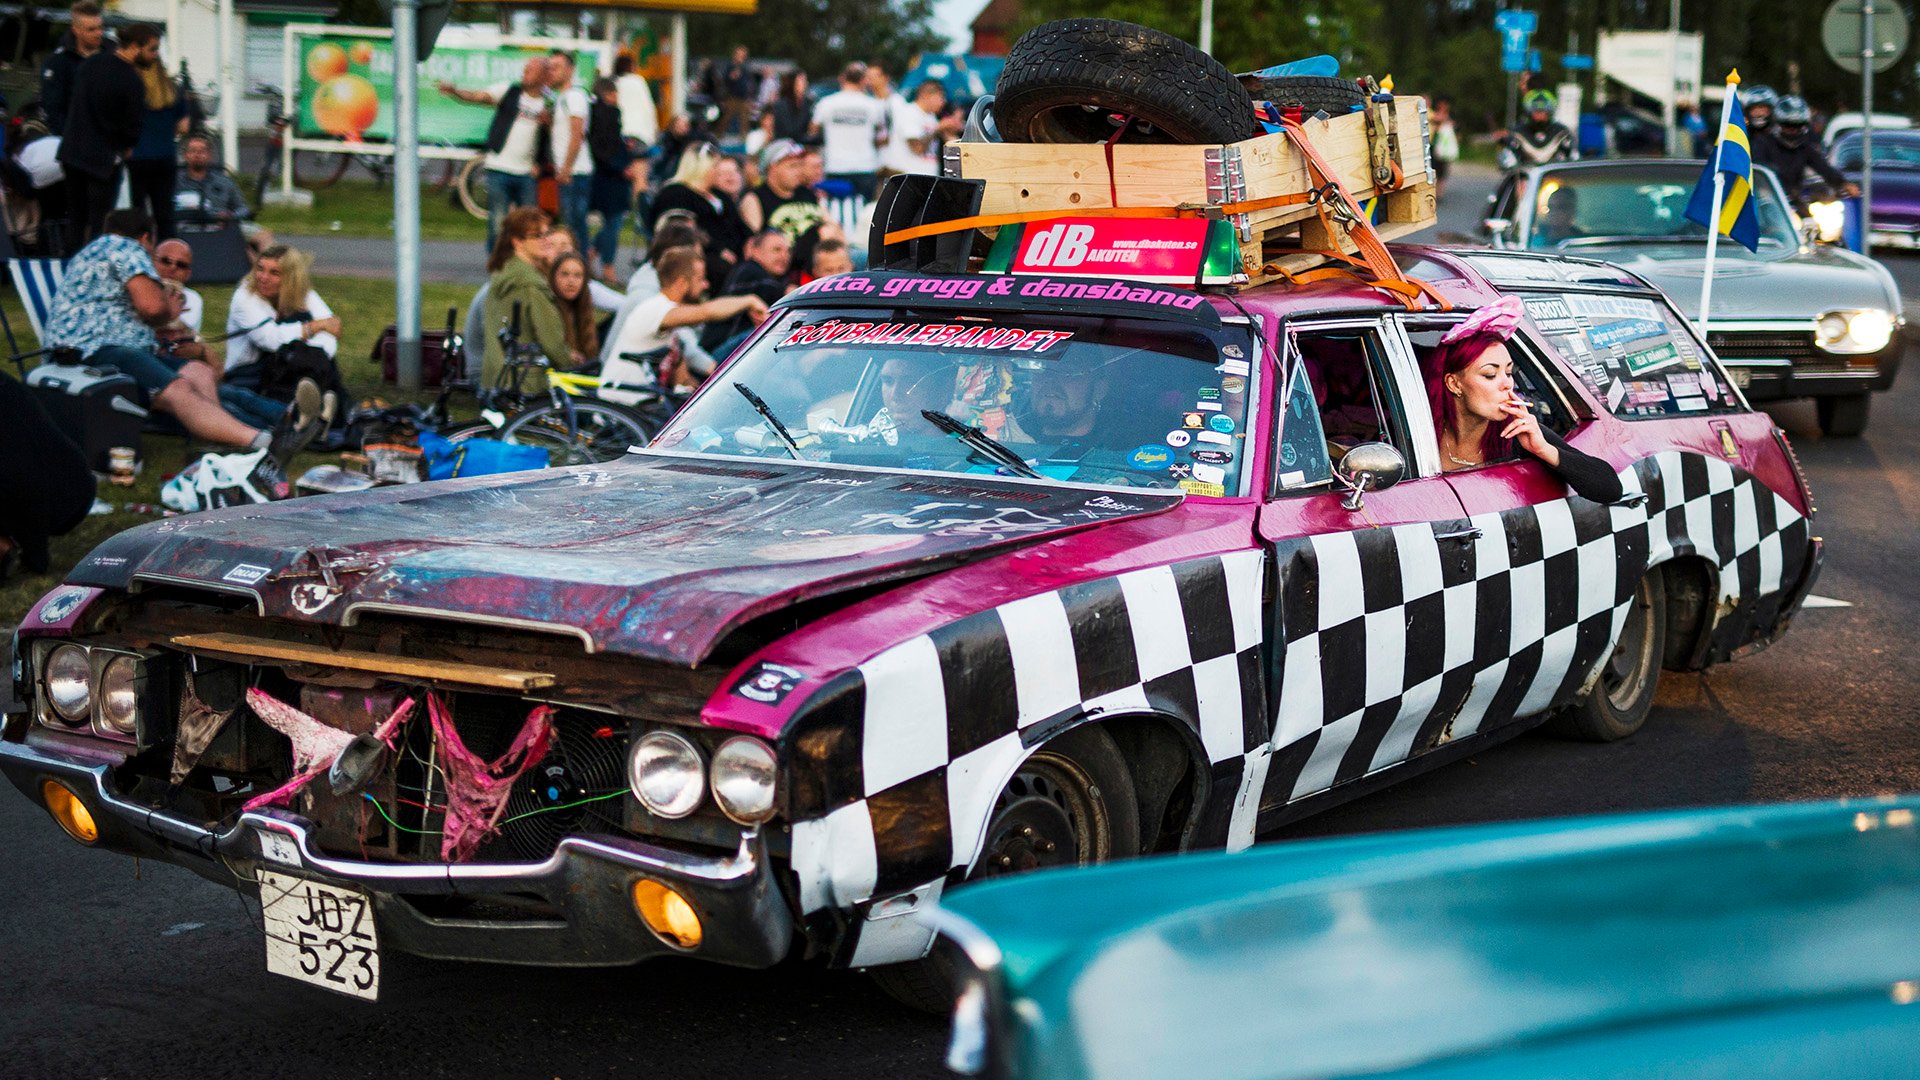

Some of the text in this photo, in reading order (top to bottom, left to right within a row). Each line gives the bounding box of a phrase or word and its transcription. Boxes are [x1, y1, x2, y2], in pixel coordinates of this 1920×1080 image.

[1023, 224, 1095, 267] dB
[1086, 249, 1141, 263] AKUTEN
[1112, 239, 1198, 250] www.dbakuten.se
[878, 277, 986, 300] grogg
[986, 277, 1016, 295] &
[1020, 278, 1206, 311] dansband
[1526, 300, 1570, 319] SKROTA
[779, 319, 1073, 354] RÖVBALLEBANDET
[1191, 482, 1213, 490] SUPPORT
[297, 886, 373, 941] JDZ
[299, 931, 374, 990] 523
